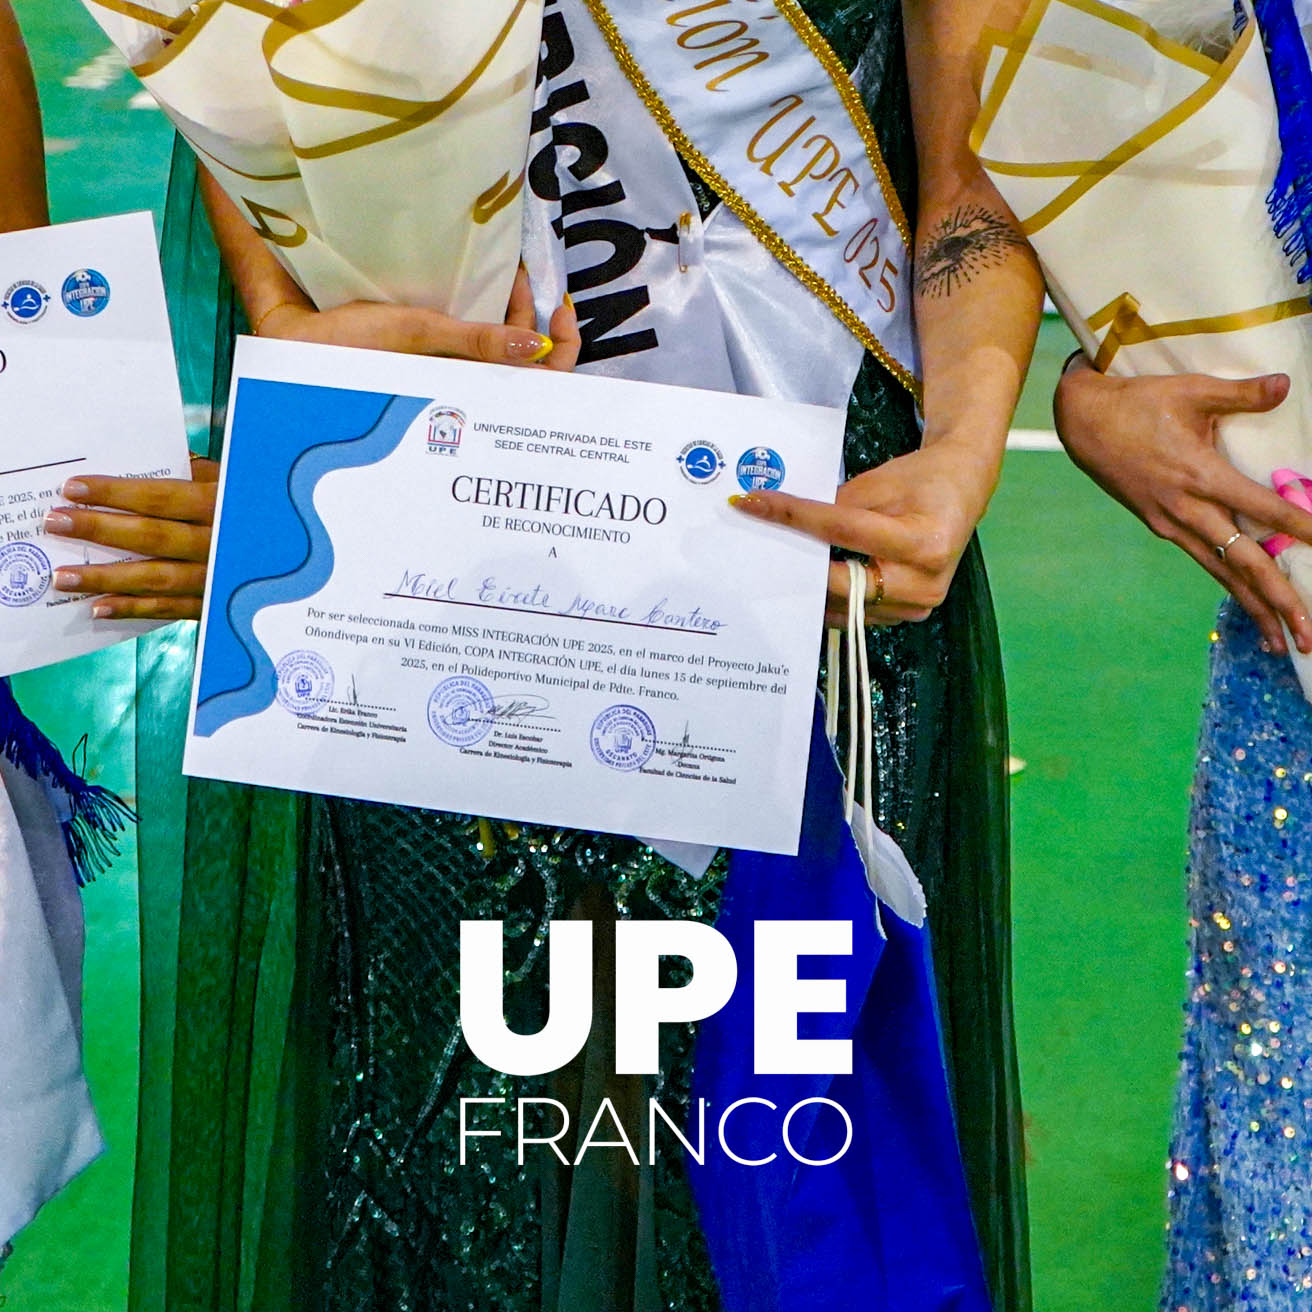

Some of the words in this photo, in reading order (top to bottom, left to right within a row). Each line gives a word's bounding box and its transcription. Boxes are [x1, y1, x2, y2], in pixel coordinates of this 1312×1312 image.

[747, 94, 860, 237] UPE
[427, 445, 458, 456] UPE
[473, 422, 546, 438] UNIVERSIDAD
[549, 431, 596, 444] PRIVADA
[600, 437, 619, 447] DEL
[623, 439, 651, 451] ESTE
[494, 439, 523, 450] SEDE
[526, 443, 575, 456] CENTRAL
[579, 449, 629, 463] CENTRAL
[8, 491, 35, 504] 2025,
[37, 488, 54, 500] en
[452, 475, 666, 524] CERTIFICADO
[482, 515, 500, 528] DE
[505, 517, 630, 543] RECONOCIMIENTO
[548, 546, 558, 558] A
[307, 607, 325, 618] Por
[347, 613, 414, 629] seleccionada
[418, 624, 448, 633] como
[451, 625, 478, 637] MISS
[482, 628, 559, 646] INTEGRACIÓN
[563, 638, 584, 650] UPE
[587, 642, 615, 655] 2025,
[619, 648, 632, 656] en
[636, 648, 645, 658] el
[649, 651, 684, 662] marco
[687, 654, 703, 665] del
[708, 656, 754, 671] Proyecto
[305, 625, 367, 644] Oñondivepa
[371, 636, 384, 644] en
[404, 638, 414, 648] VI
[418, 639, 460, 655] Edición,
[464, 645, 494, 658] COPA
[498, 649, 575, 668] INTEGRACIÓN
[579, 659, 602, 672] UPE,
[606, 663, 616, 673] el
[619, 664, 636, 676] día
[640, 667, 669, 679] lunes
[674, 672, 685, 681] 15
[689, 673, 702, 683] de
[705, 678, 767, 691] septiembre
[770, 683, 786, 694] del
[400, 657, 427, 670] 2025,
[431, 663, 444, 671] en
[448, 662, 457, 672] el
[461, 663, 531, 681] Polideportivo
[535, 673, 589, 690] Municipal
[592, 680, 605, 690] de
[609, 682, 634, 694] Pdte.
[638, 685, 678, 700] Franco.
